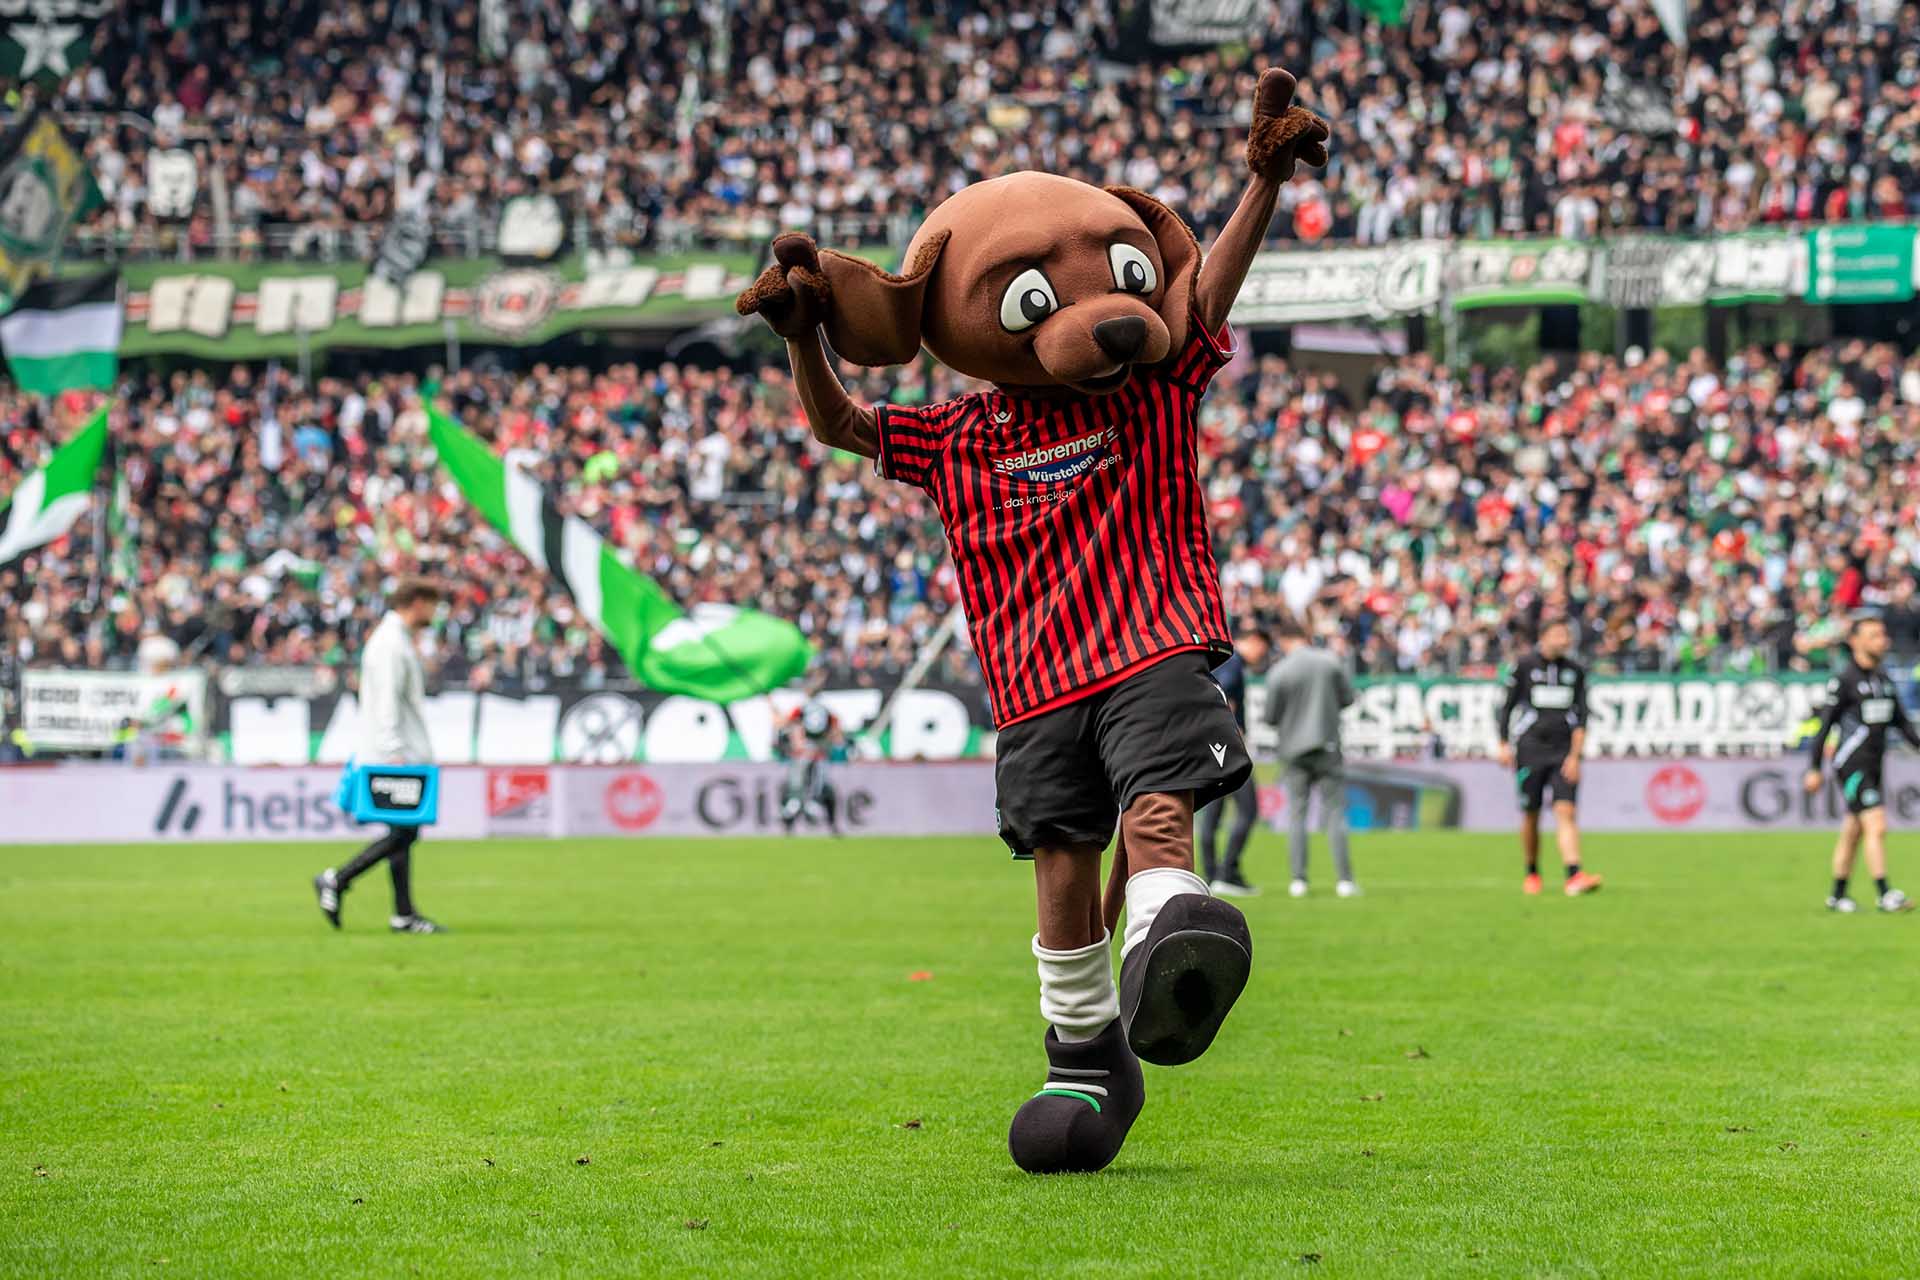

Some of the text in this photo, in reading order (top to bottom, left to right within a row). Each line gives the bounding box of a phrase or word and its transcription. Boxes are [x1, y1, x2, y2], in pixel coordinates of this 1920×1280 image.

[1027, 454, 1095, 482] Würstchen
[1004, 497, 1025, 509] das
[696, 776, 875, 829] Gie
[1740, 768, 1920, 822] Gile
